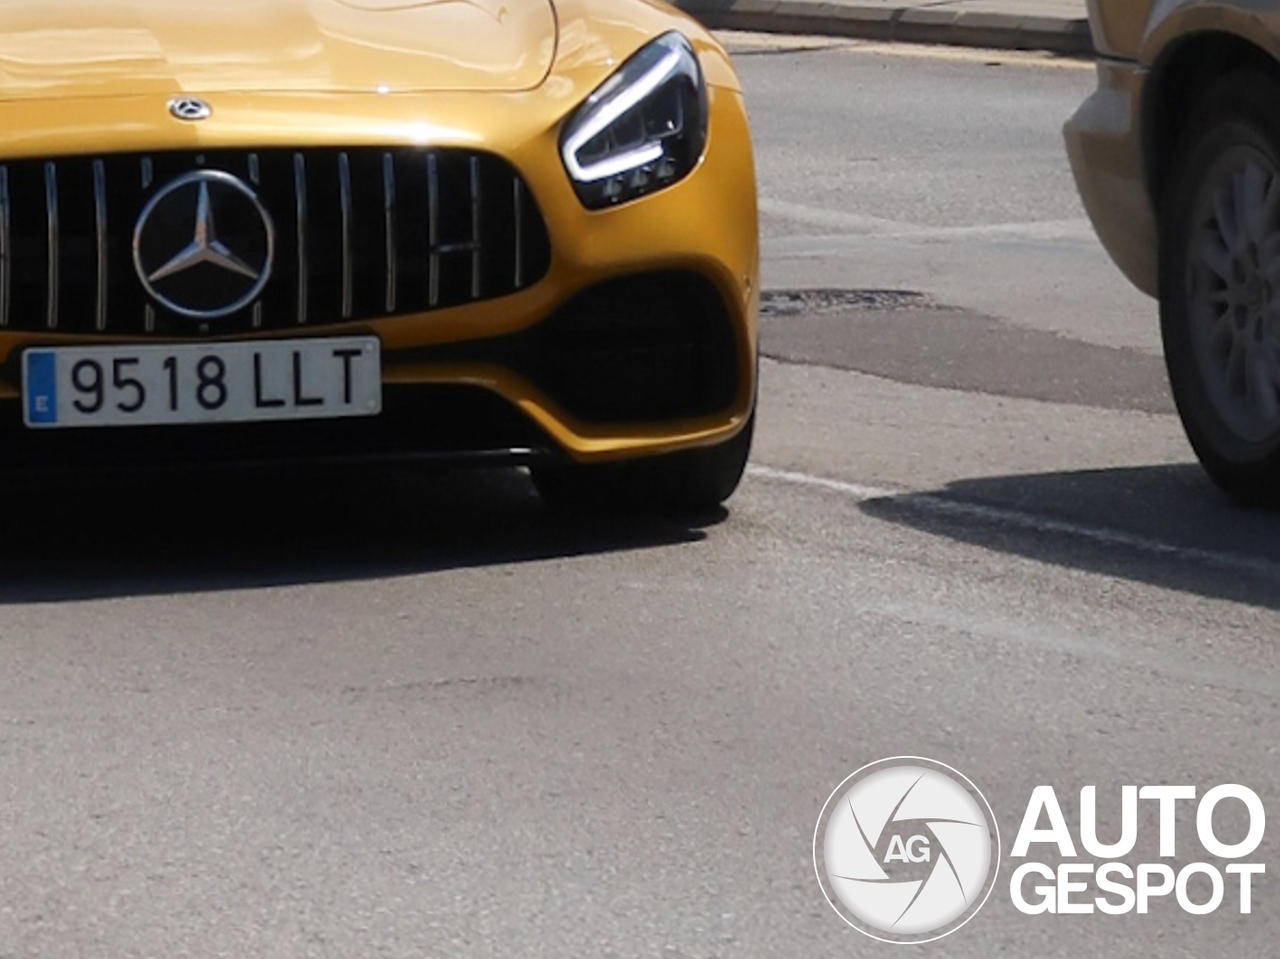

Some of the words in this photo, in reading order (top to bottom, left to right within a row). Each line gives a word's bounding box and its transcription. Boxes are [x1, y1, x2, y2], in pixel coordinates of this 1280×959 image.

[71, 354, 227, 414] 9518
[253, 348, 363, 409] LLT
[35, 396, 49, 413] E
